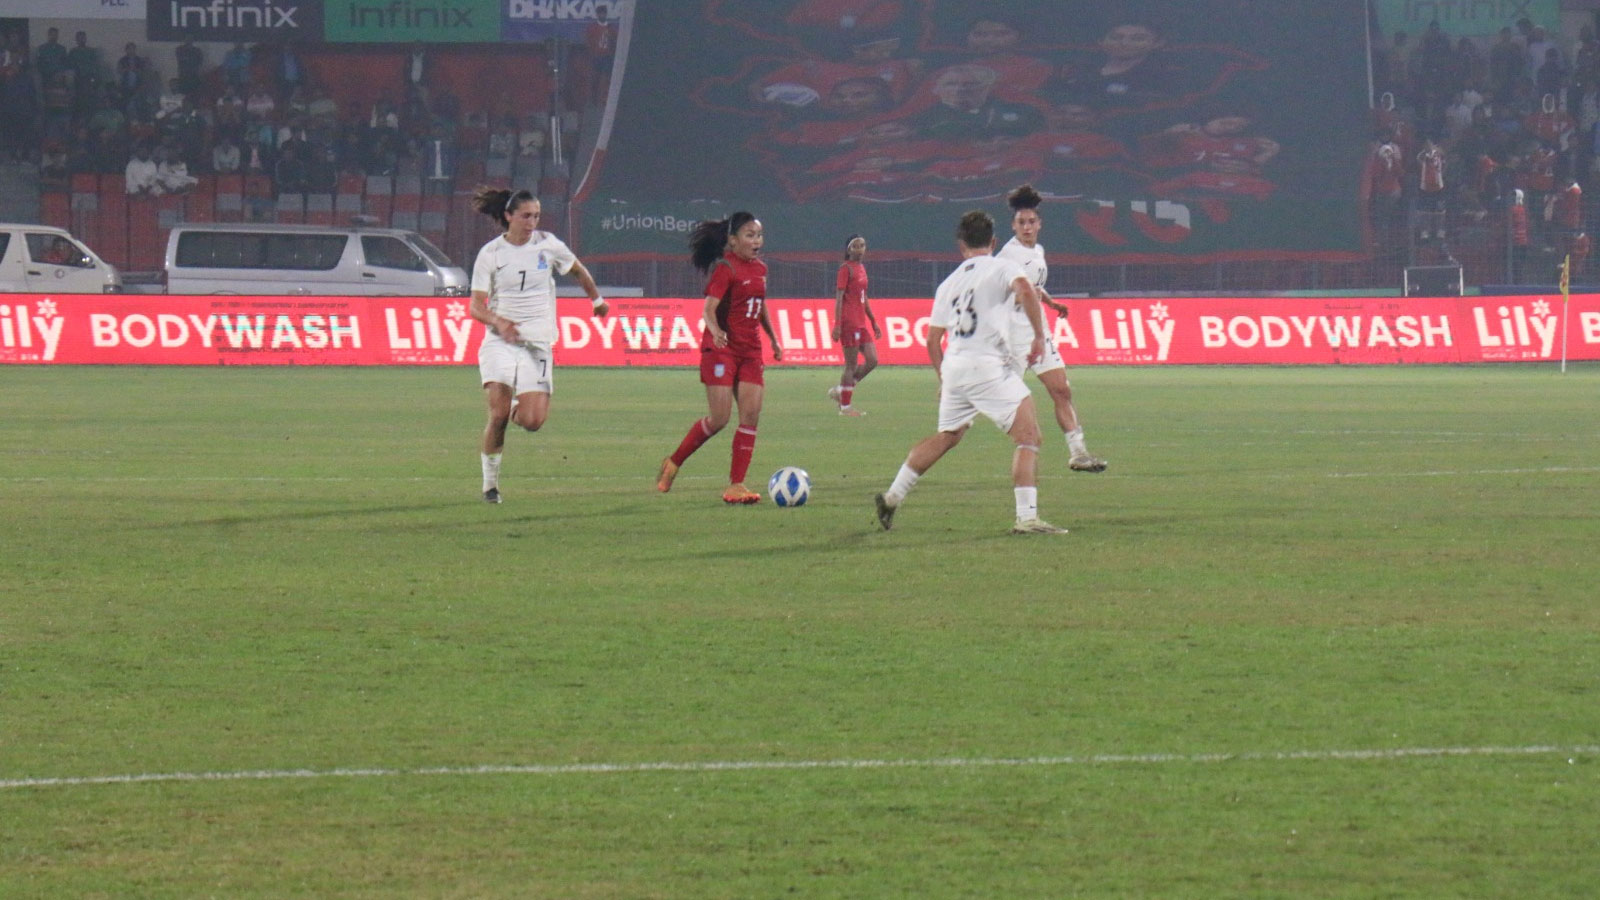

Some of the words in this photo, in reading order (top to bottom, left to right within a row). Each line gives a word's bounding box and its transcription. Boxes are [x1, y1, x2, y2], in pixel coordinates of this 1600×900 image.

[171, 0, 299, 27] Infinix
[349, 0, 473, 27] Infinix
[518, 270, 526, 291] 7
[90, 313, 362, 349] BODYWASH
[384, 307, 474, 362] Lily
[777, 308, 833, 350] Lil
[1090, 308, 1175, 361] Lily
[1199, 315, 1453, 348] BODYWASH
[1473, 305, 1557, 357] Lily
[540, 359, 546, 377] 7
